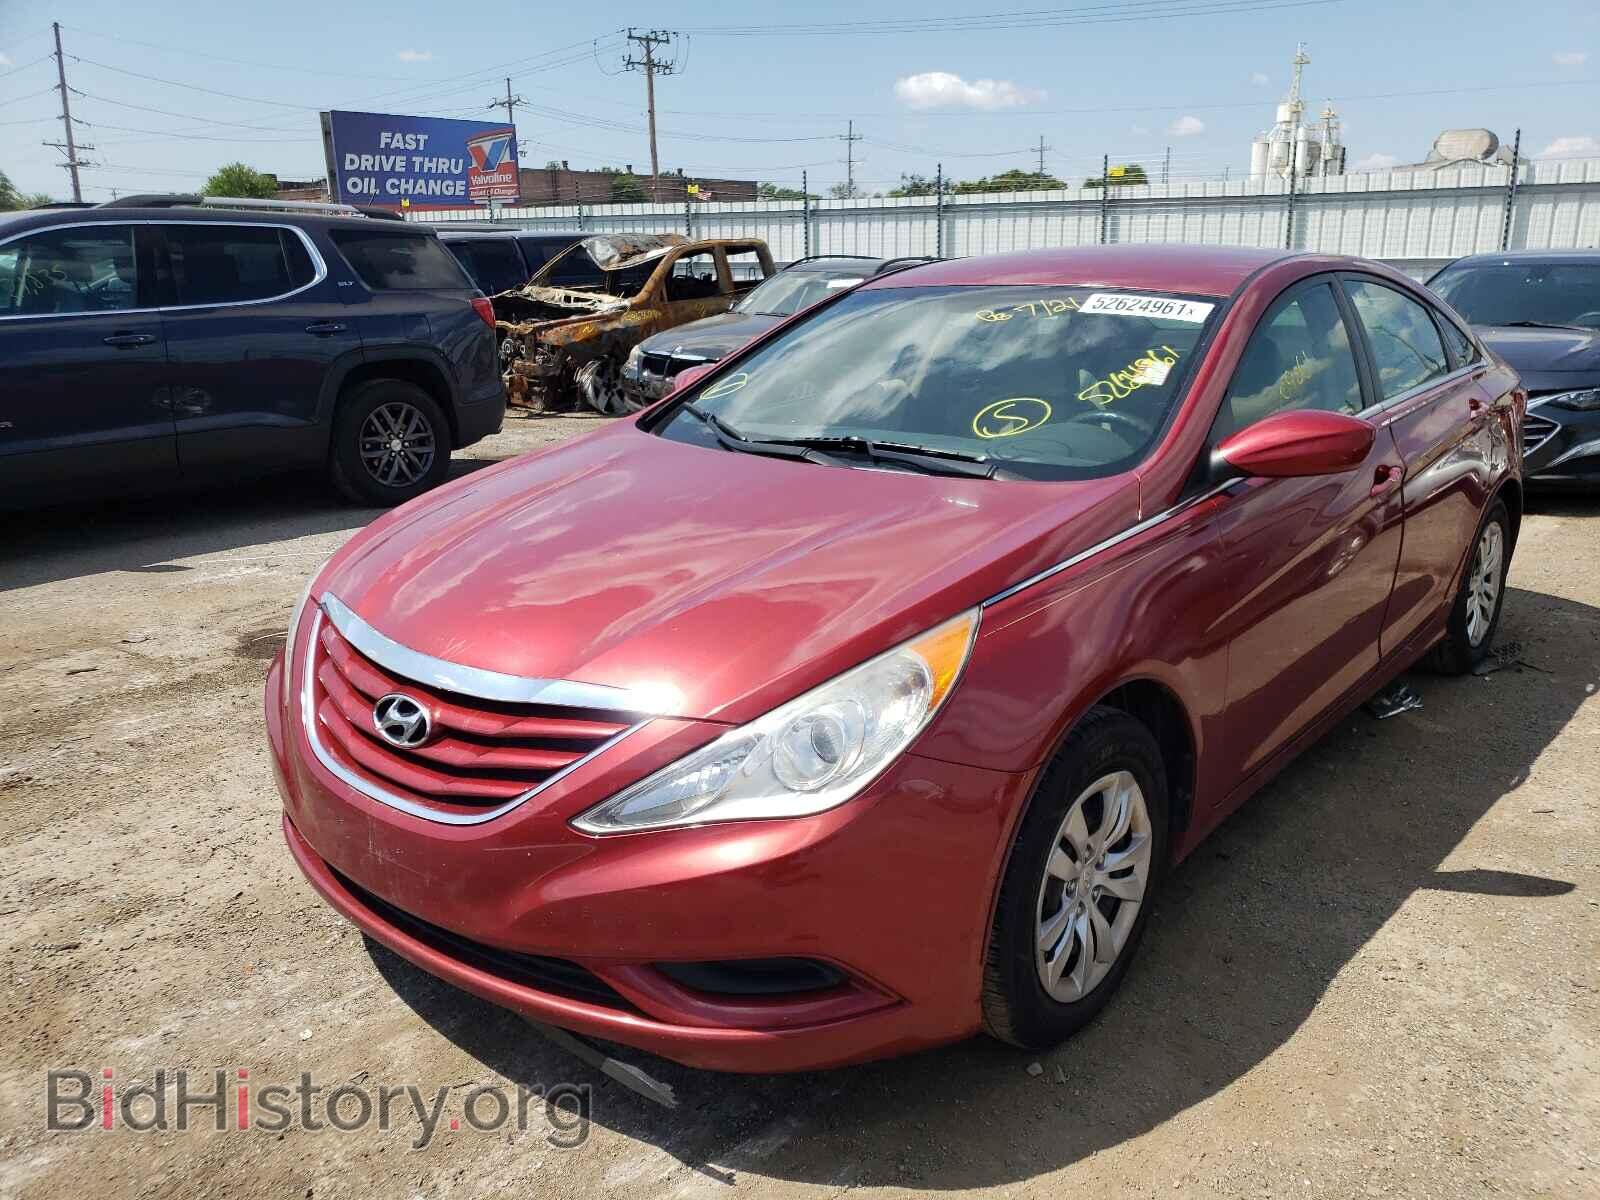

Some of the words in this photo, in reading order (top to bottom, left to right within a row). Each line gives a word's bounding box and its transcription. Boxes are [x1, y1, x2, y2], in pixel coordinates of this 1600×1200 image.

[380, 132, 428, 150] FAST
[344, 153, 407, 171] DRIVE
[412, 156, 464, 174] THRU
[346, 177, 379, 195] OIL
[385, 178, 466, 195] CHANGE
[471, 173, 512, 185] Valvoline
[1091, 296, 1187, 316] 52624961
